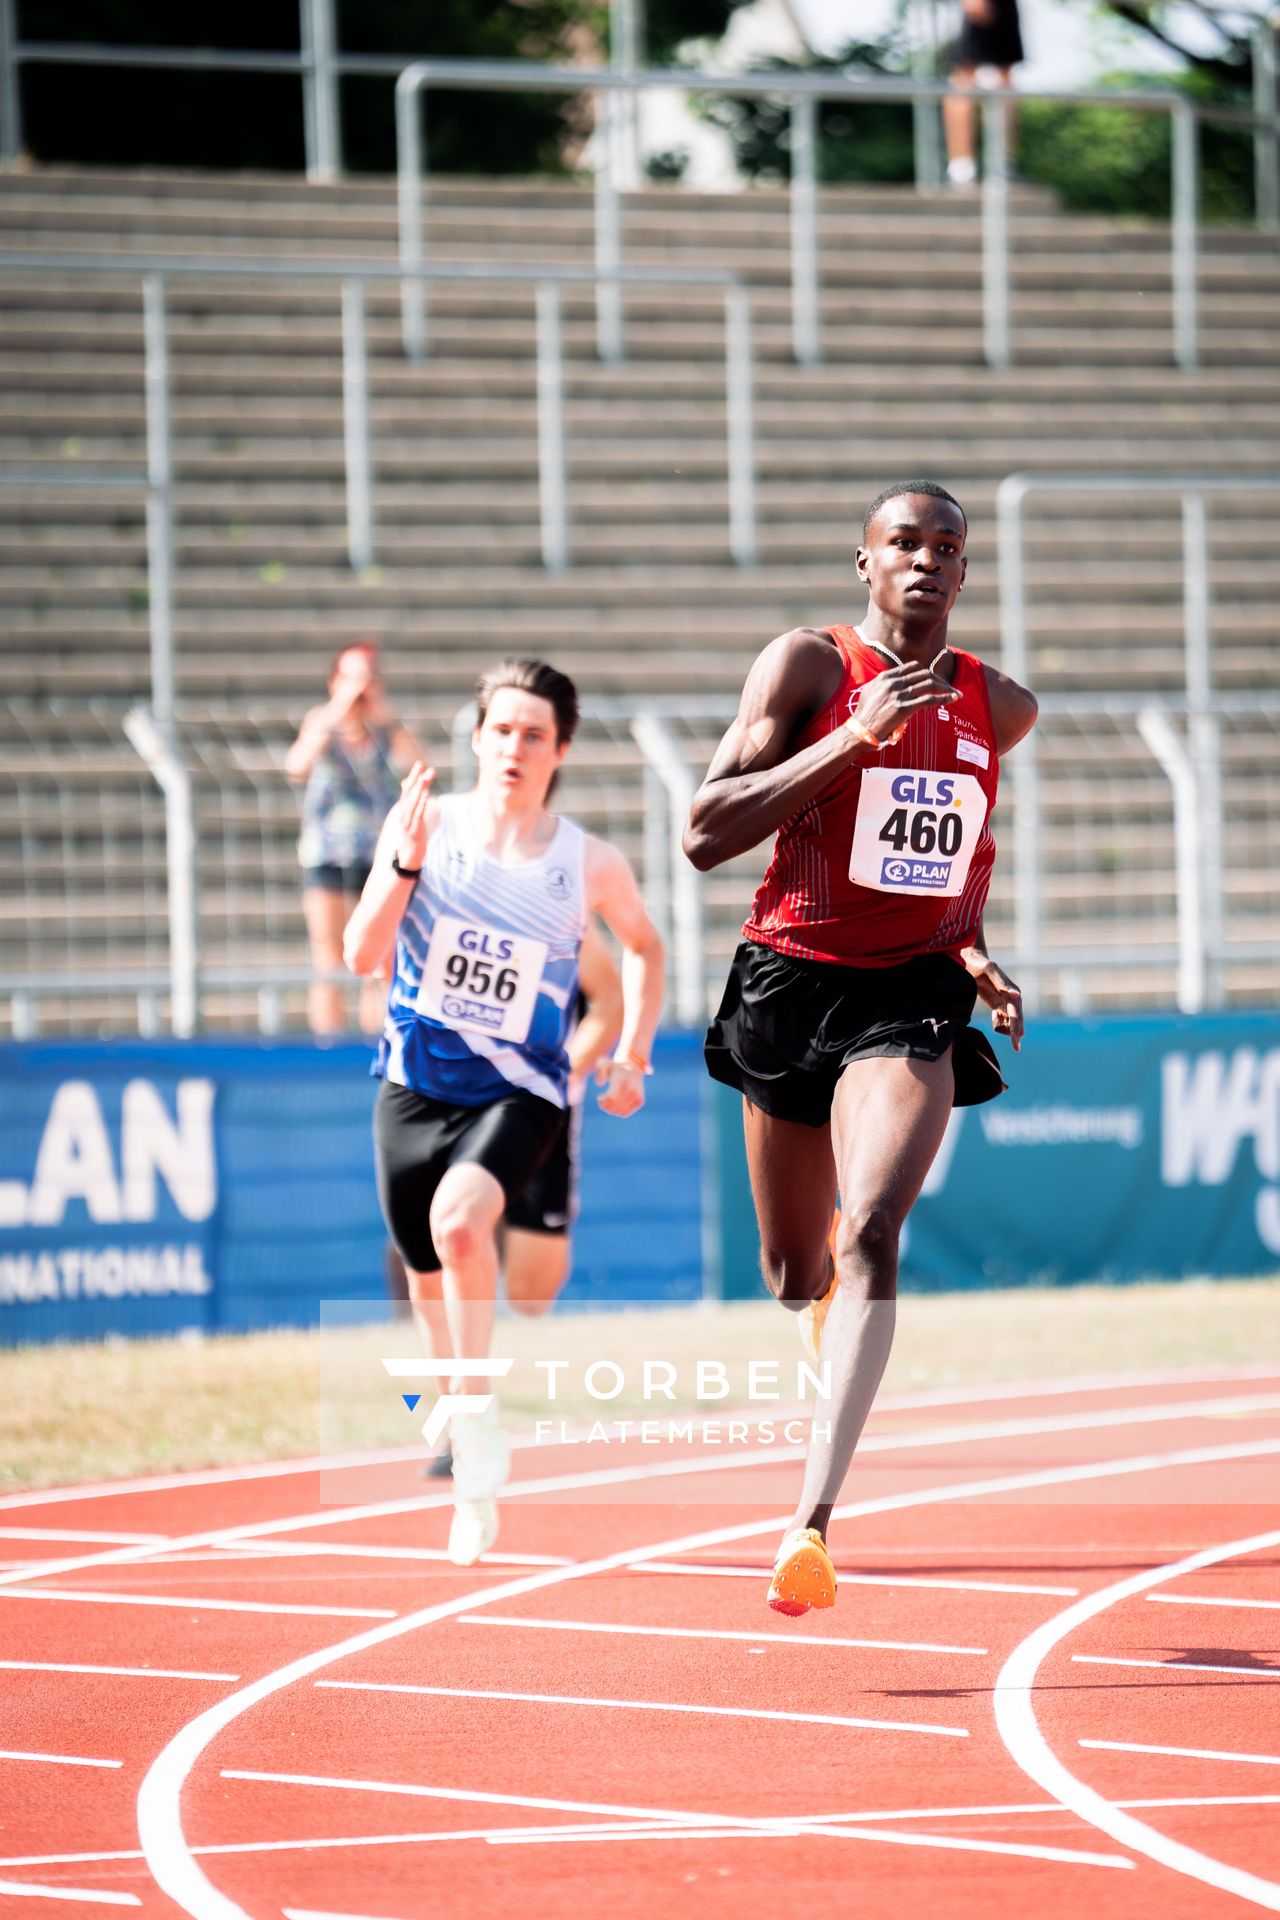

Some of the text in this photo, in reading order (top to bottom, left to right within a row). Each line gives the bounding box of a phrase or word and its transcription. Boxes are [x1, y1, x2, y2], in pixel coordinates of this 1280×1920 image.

[878, 808, 963, 857] 460
[912, 864, 949, 880] PLAN
[443, 954, 519, 1002] 956
